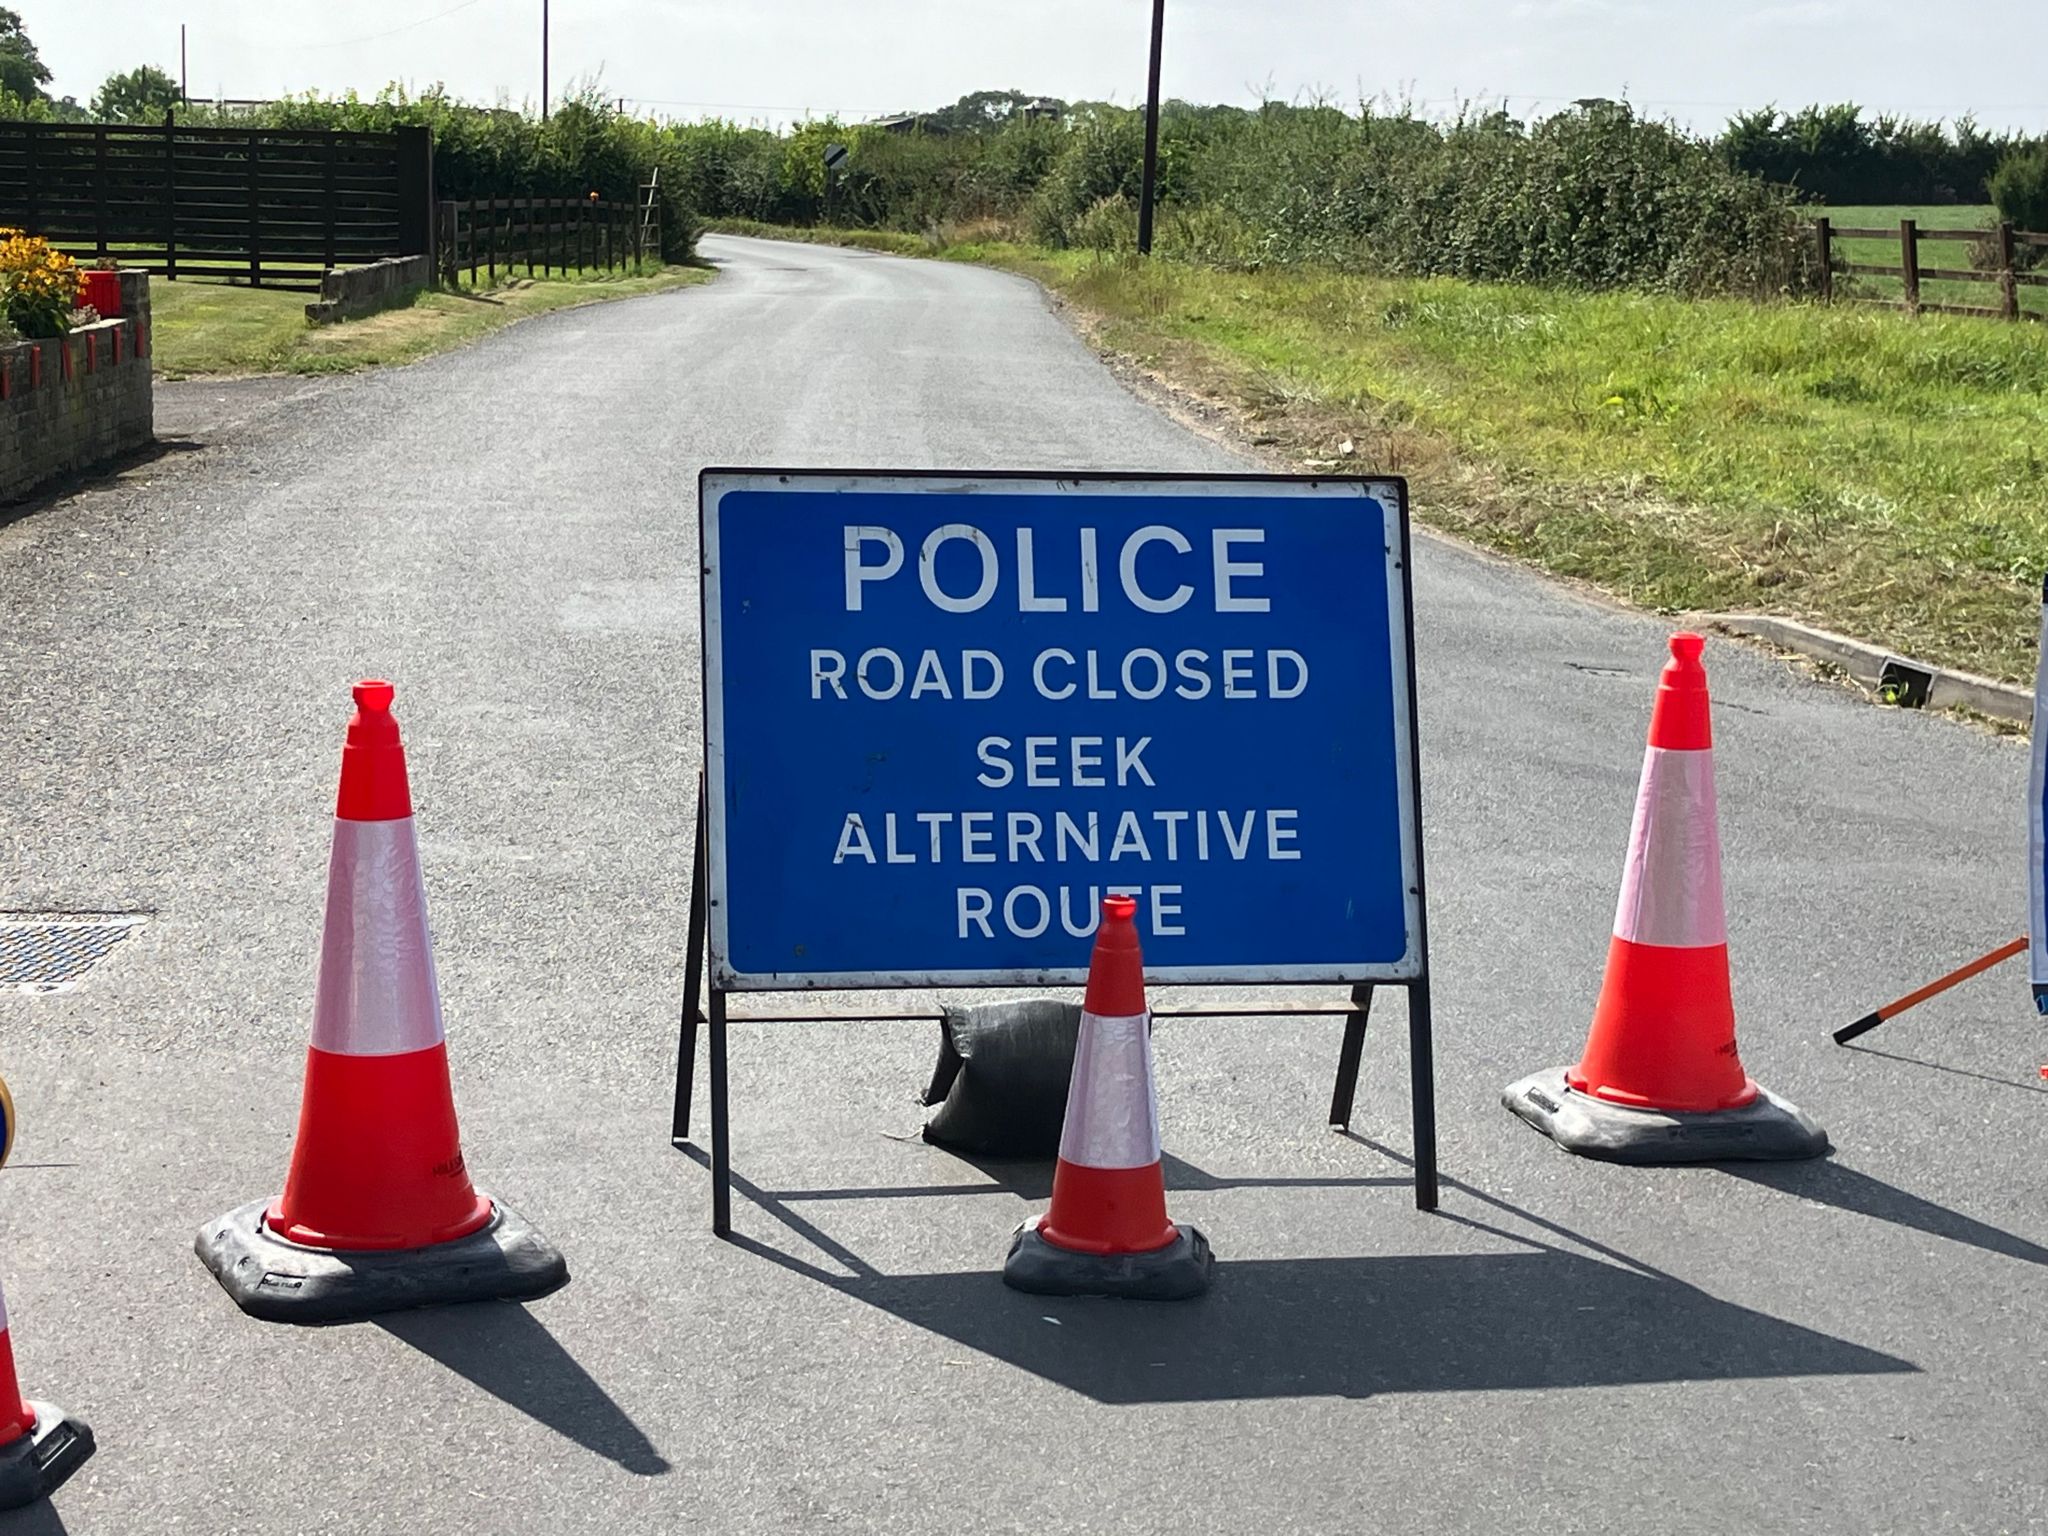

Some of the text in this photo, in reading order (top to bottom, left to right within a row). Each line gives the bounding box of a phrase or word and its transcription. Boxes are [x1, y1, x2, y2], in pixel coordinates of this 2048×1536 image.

[845, 524, 1271, 613] POLICE
[810, 647, 1308, 700] ROAD CLOSED
[977, 736, 1156, 788] SEEK
[833, 810, 1301, 864] ALTERNATIVE
